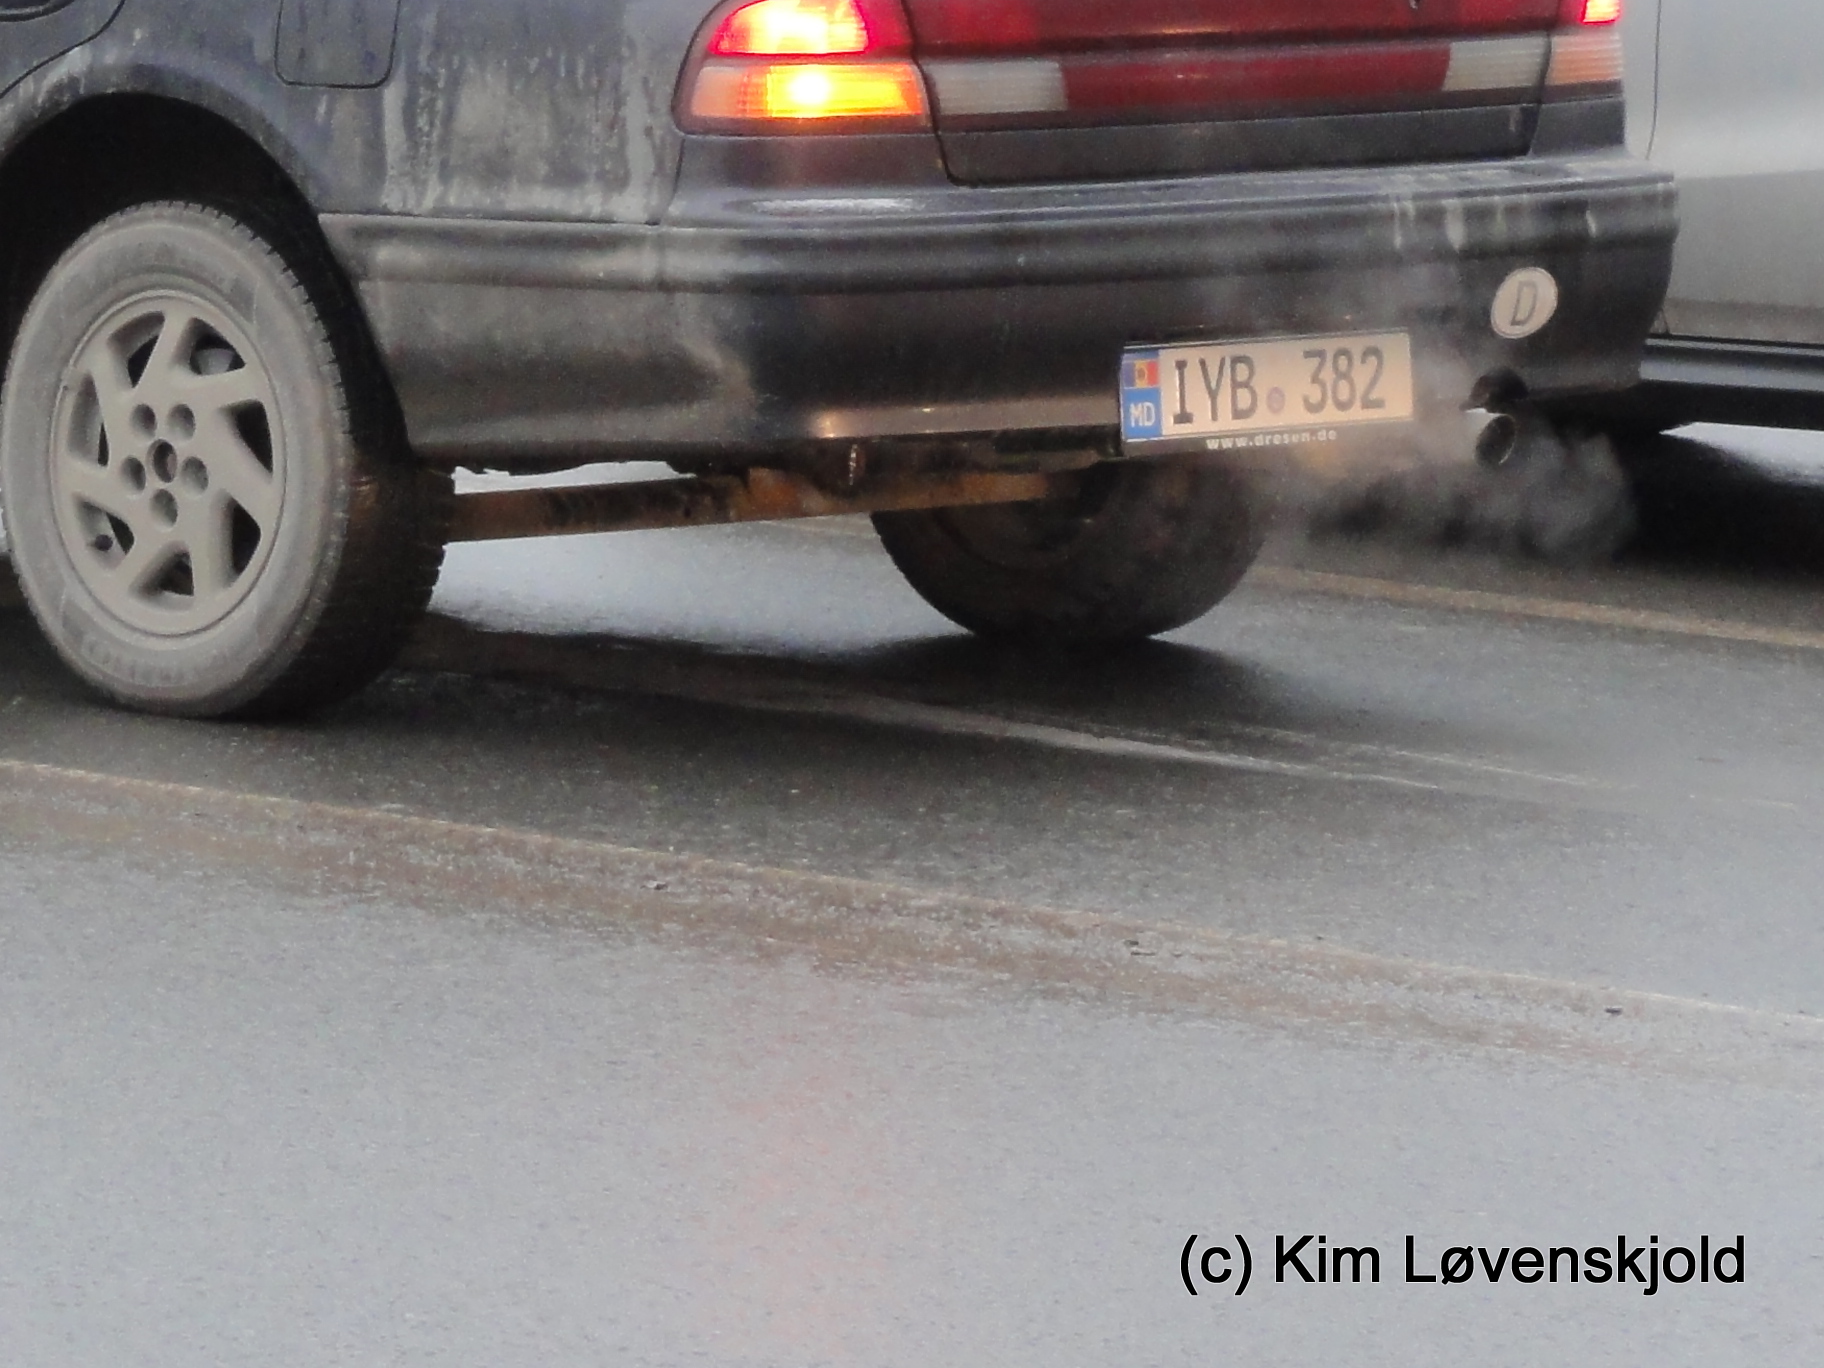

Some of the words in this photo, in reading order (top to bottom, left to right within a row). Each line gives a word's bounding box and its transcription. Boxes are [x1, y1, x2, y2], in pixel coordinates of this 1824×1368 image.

[1510, 280, 1539, 327] D
[1172, 354, 1259, 426] IYB
[1302, 344, 1387, 416] 382
[1129, 401, 1156, 429] MD
